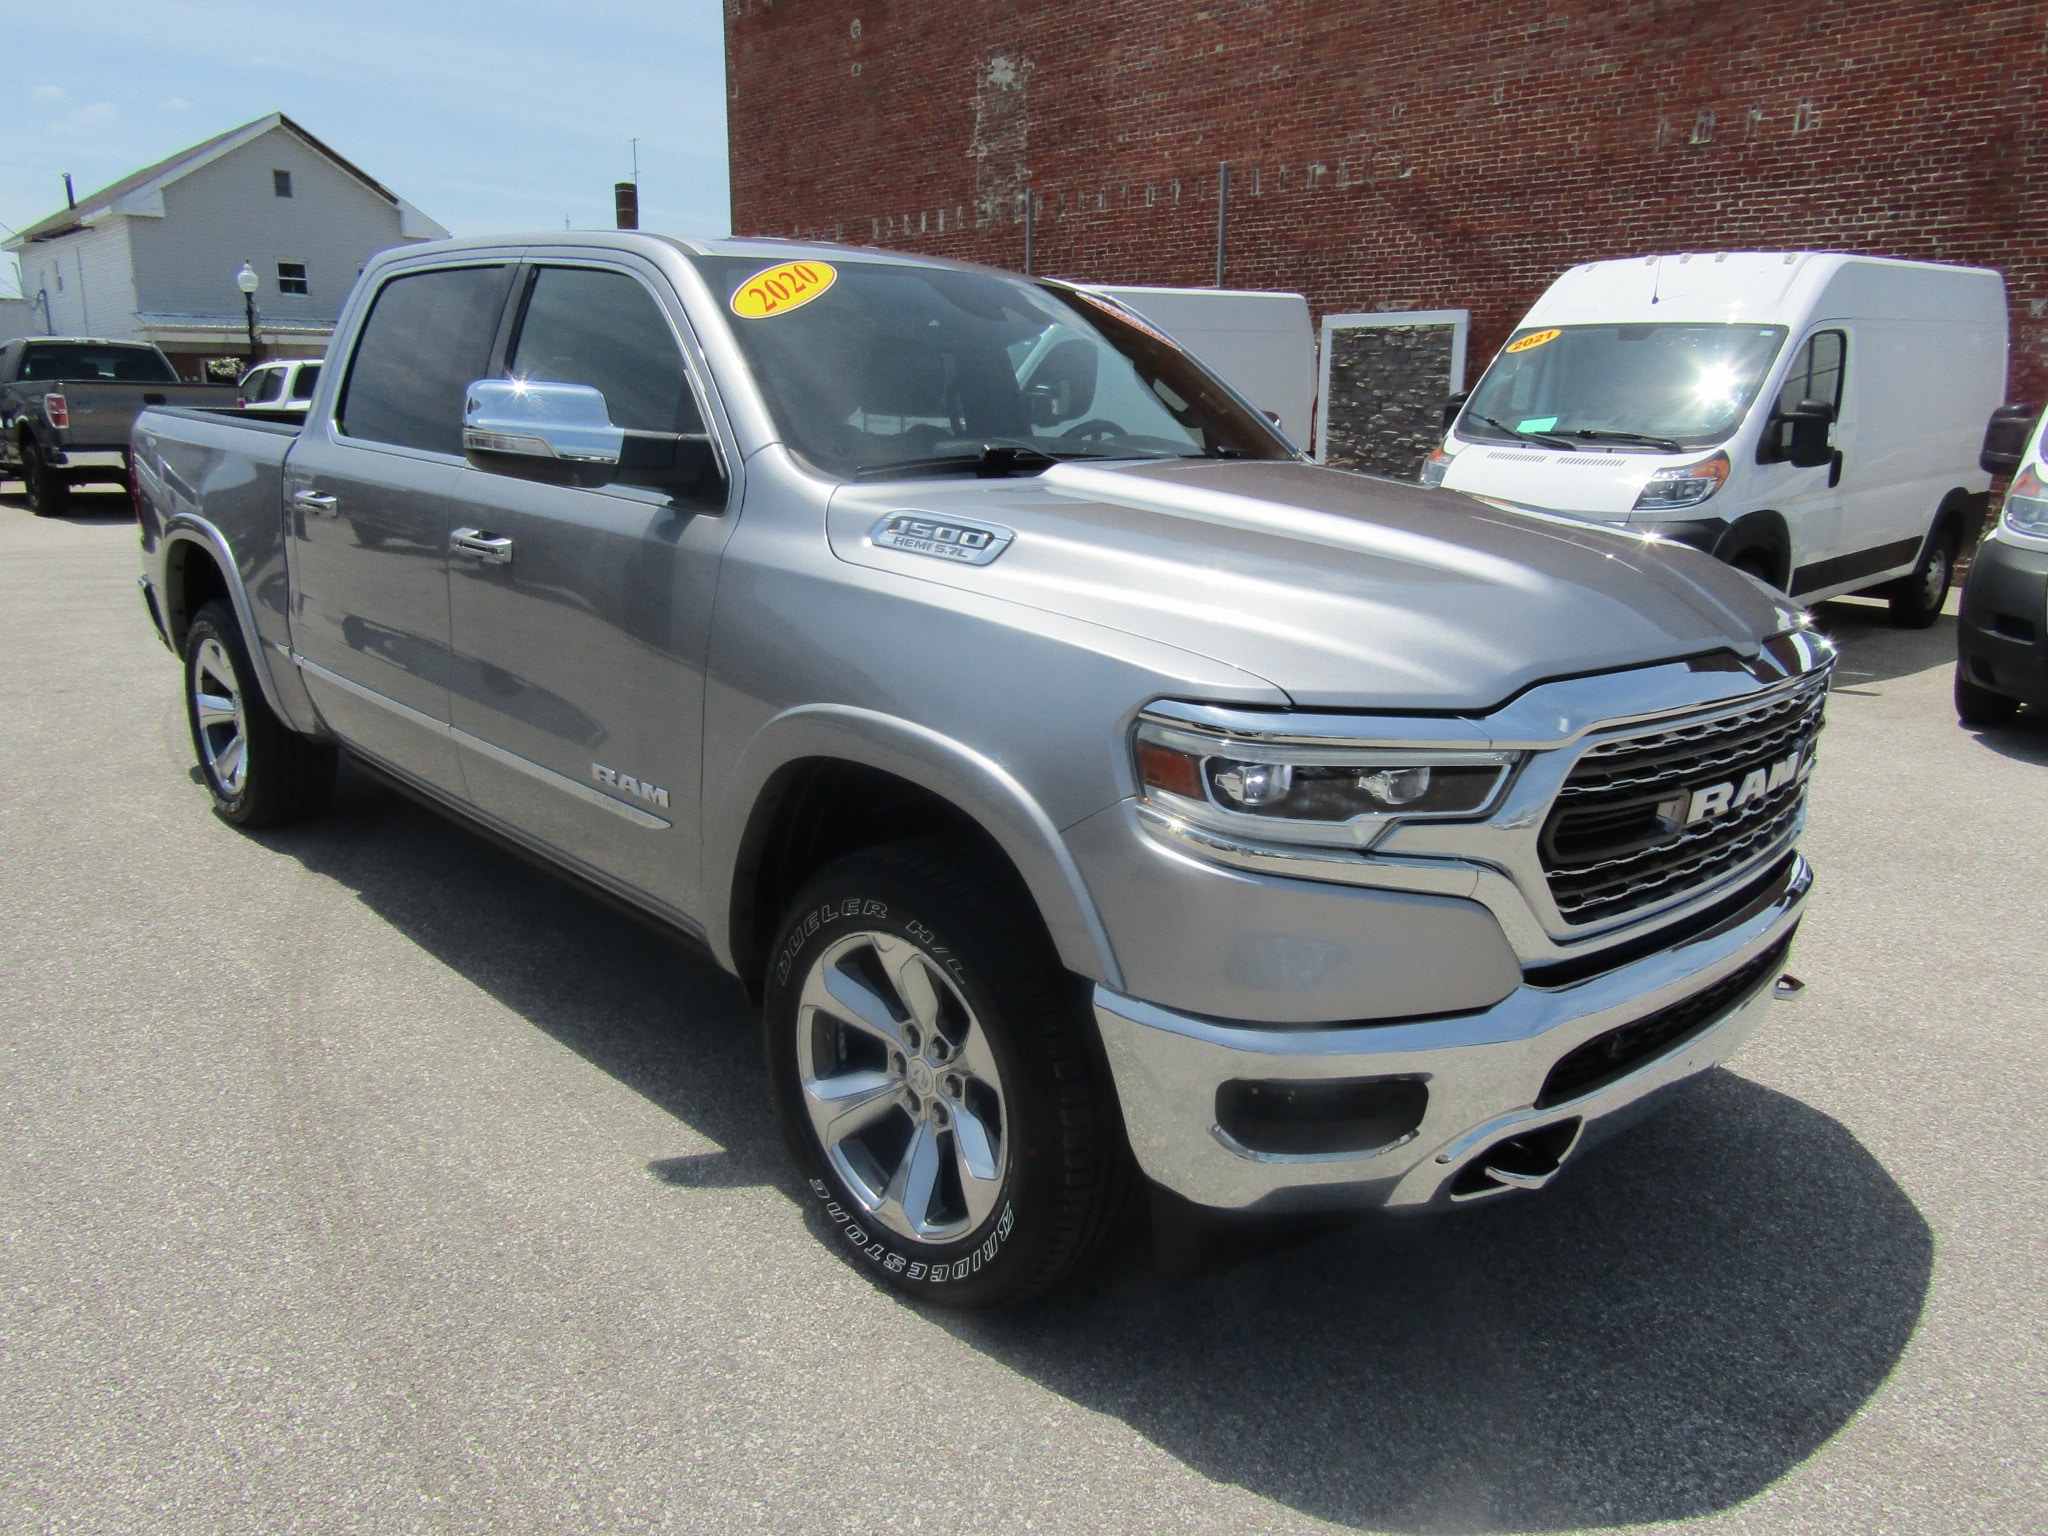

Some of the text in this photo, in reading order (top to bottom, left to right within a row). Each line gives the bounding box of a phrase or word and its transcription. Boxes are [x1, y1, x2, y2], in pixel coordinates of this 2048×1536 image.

[749, 264, 819, 312] 2020
[1511, 330, 1554, 351] 2021
[887, 519, 989, 549] 1500
[893, 536, 969, 558] HEMI 5.7L
[592, 762, 670, 808] RAM
[1686, 751, 1800, 824] RAM
[777, 898, 888, 987] DUELER
[809, 1178, 1015, 1282] BRIDGESTONE
